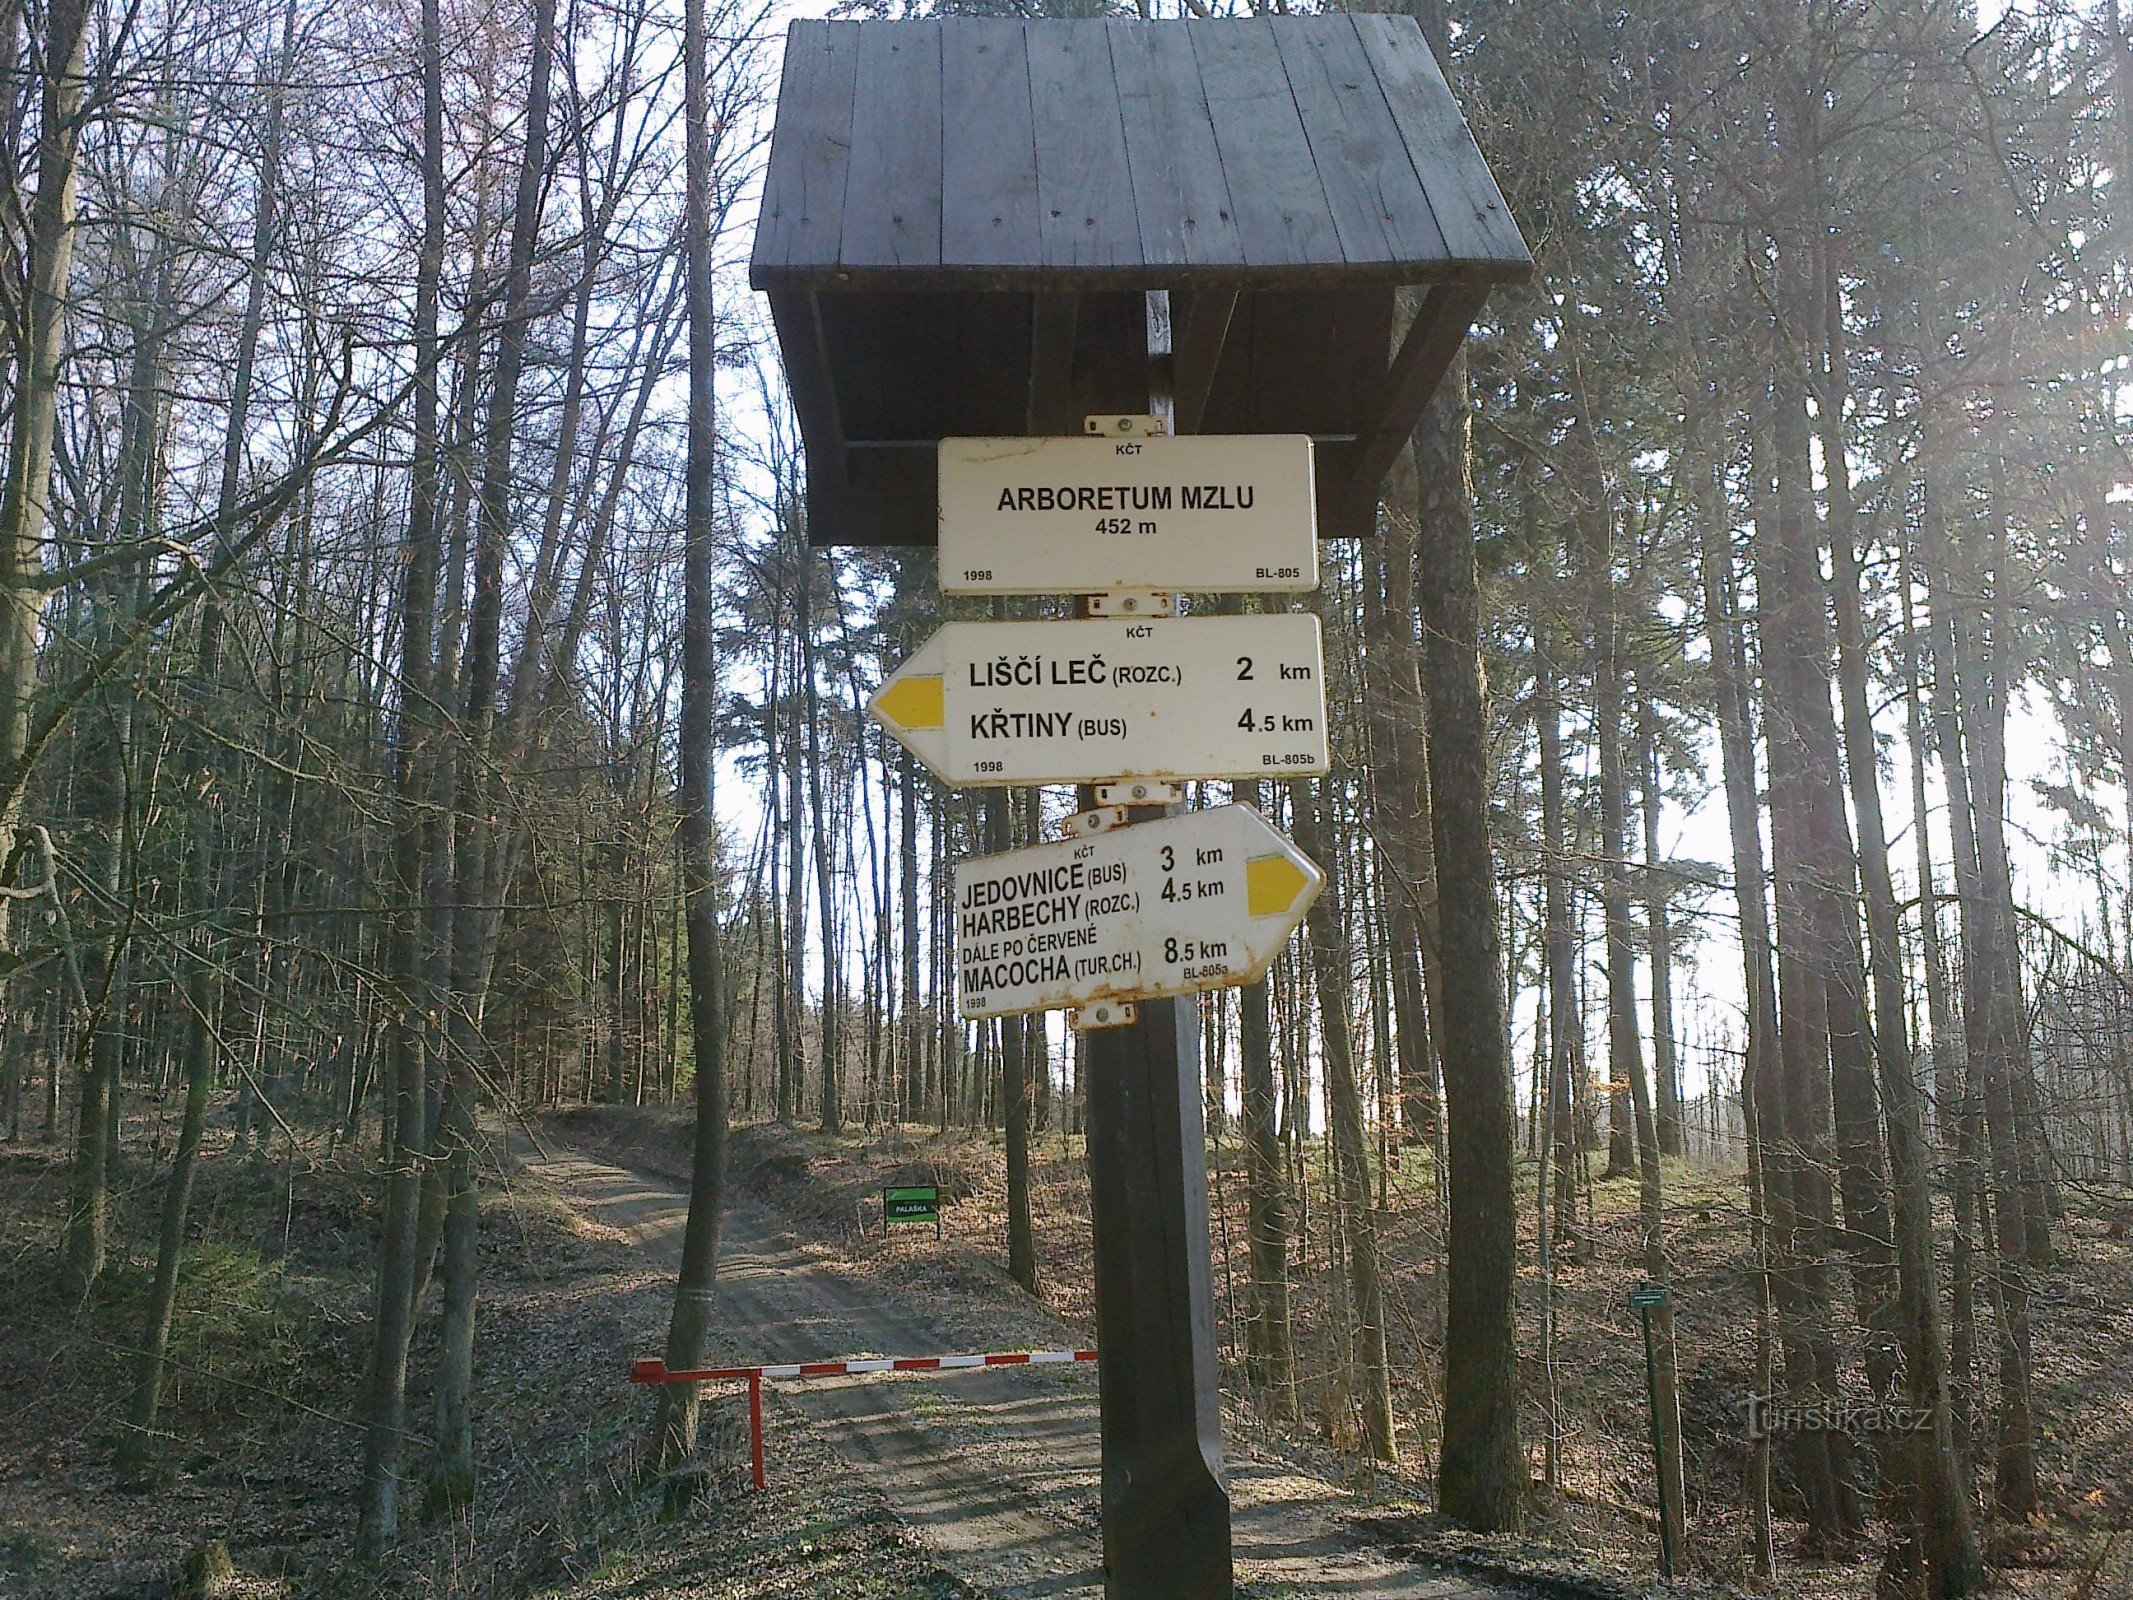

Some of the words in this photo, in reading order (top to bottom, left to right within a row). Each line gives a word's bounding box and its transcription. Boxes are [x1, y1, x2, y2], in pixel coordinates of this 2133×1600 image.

[1116, 443, 1142, 455] KČT
[998, 486, 1172, 511] ARBORETUM
[1181, 485, 1254, 509] MZLU
[1095, 519, 1131, 534] 452
[1138, 522, 1156, 534] m
[963, 571, 992, 581] 1998
[1256, 568, 1300, 579] BL-805
[1126, 625, 1153, 639] KČT
[970, 656, 1042, 687] LIŠČÍ
[1051, 654, 1106, 685] LEČ
[1112, 664, 1182, 687] (ROZC.)
[1236, 657, 1254, 681] 2
[1279, 664, 1311, 680] km
[971, 708, 1073, 739] KŘTINY
[1078, 718, 1127, 740] (BUS)
[1237, 708, 1275, 733] 4.5
[1283, 716, 1314, 732] km
[974, 762, 1003, 772] 1998
[1262, 754, 1315, 765] BL-805b
[1074, 845, 1095, 860] KČT
[962, 863, 1084, 909] JEDOVNICE
[1088, 862, 1127, 891] (BUS)
[1160, 846, 1175, 872] 3
[1196, 846, 1223, 866] km
[963, 894, 1081, 938] HARBECHY
[1085, 892, 1140, 921] (ROZC.)
[1161, 878, 1191, 903] 4.5
[1198, 878, 1224, 898] km
[963, 946, 999, 964] DÁLE
[1003, 940, 1023, 958] PO
[1027, 926, 1097, 954] ČERVENÉ
[964, 954, 1070, 993] MACOCHA
[1075, 951, 1141, 982] (TUR.CH.)
[1164, 938, 1194, 964] 8.5
[1200, 939, 1227, 959] km
[966, 998, 986, 1009] 1998
